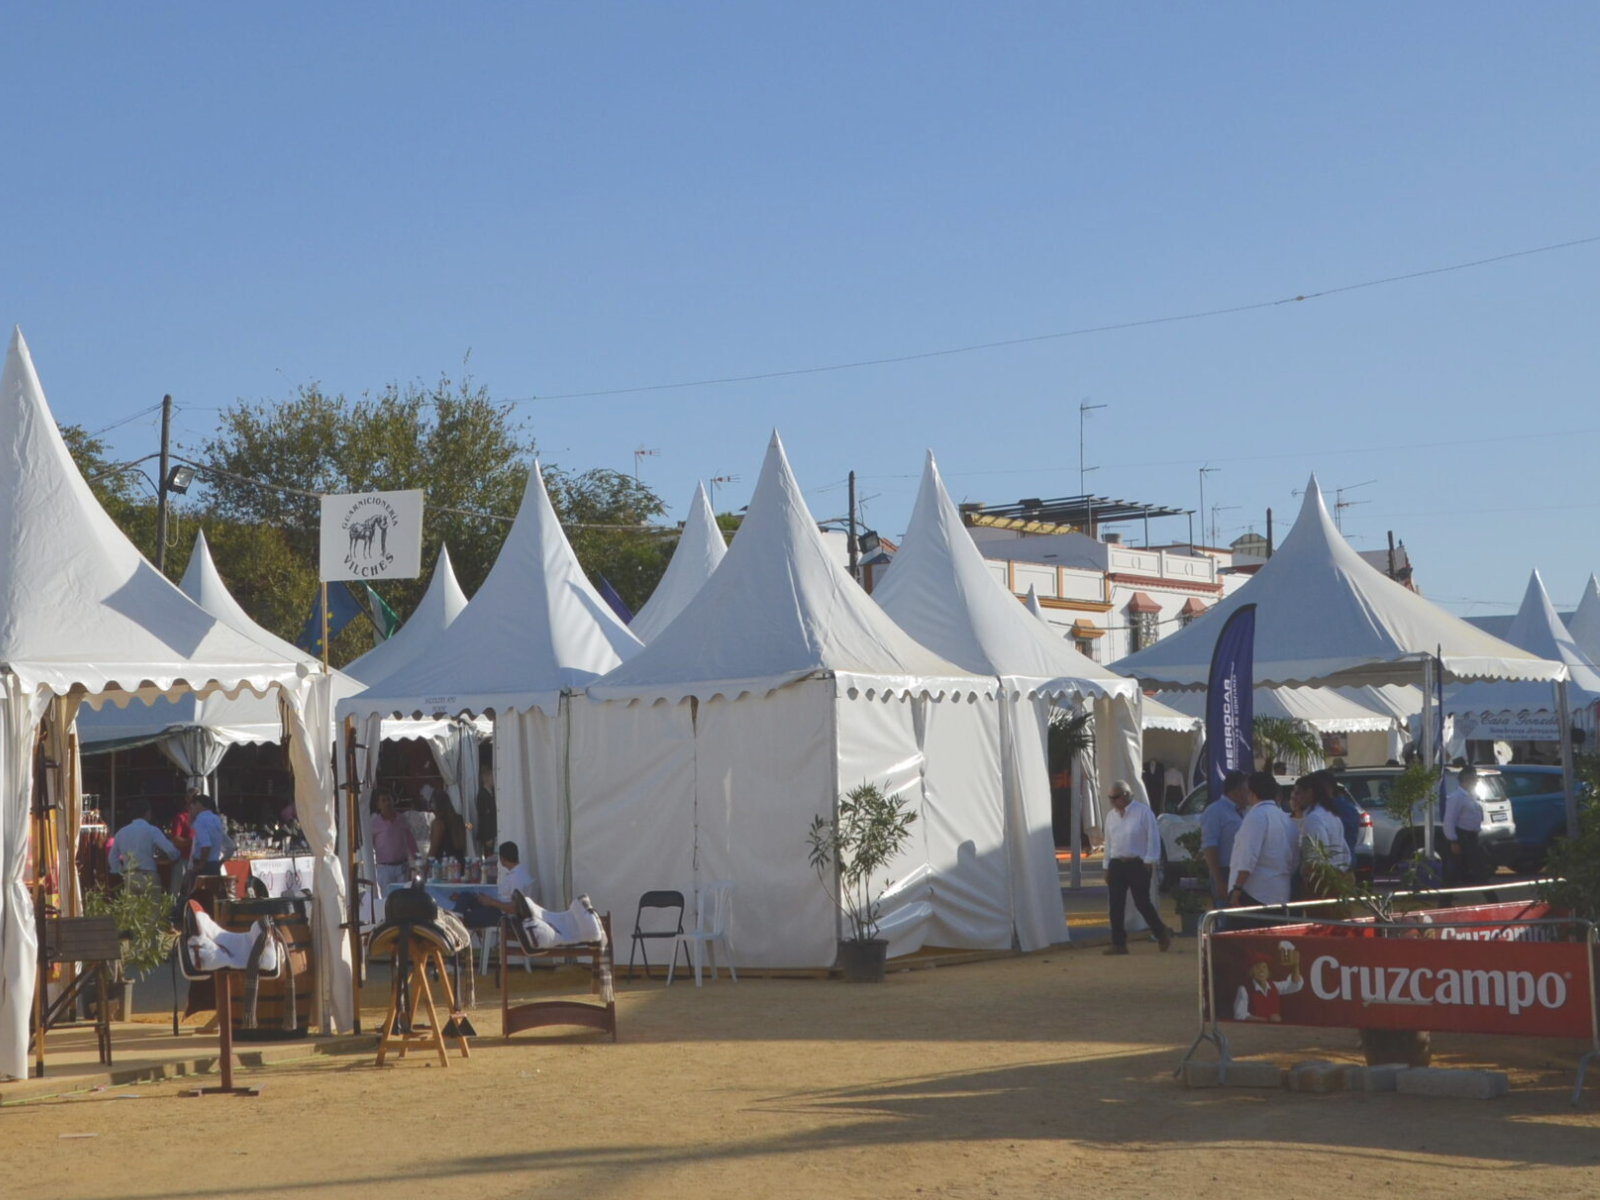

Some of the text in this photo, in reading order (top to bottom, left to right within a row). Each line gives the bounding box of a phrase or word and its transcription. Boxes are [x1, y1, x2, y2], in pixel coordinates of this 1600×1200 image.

[343, 553, 394, 577] VILCHES
[1223, 679, 1233, 770] BERROCAR
[1310, 955, 1566, 1015] Cruzcampo
